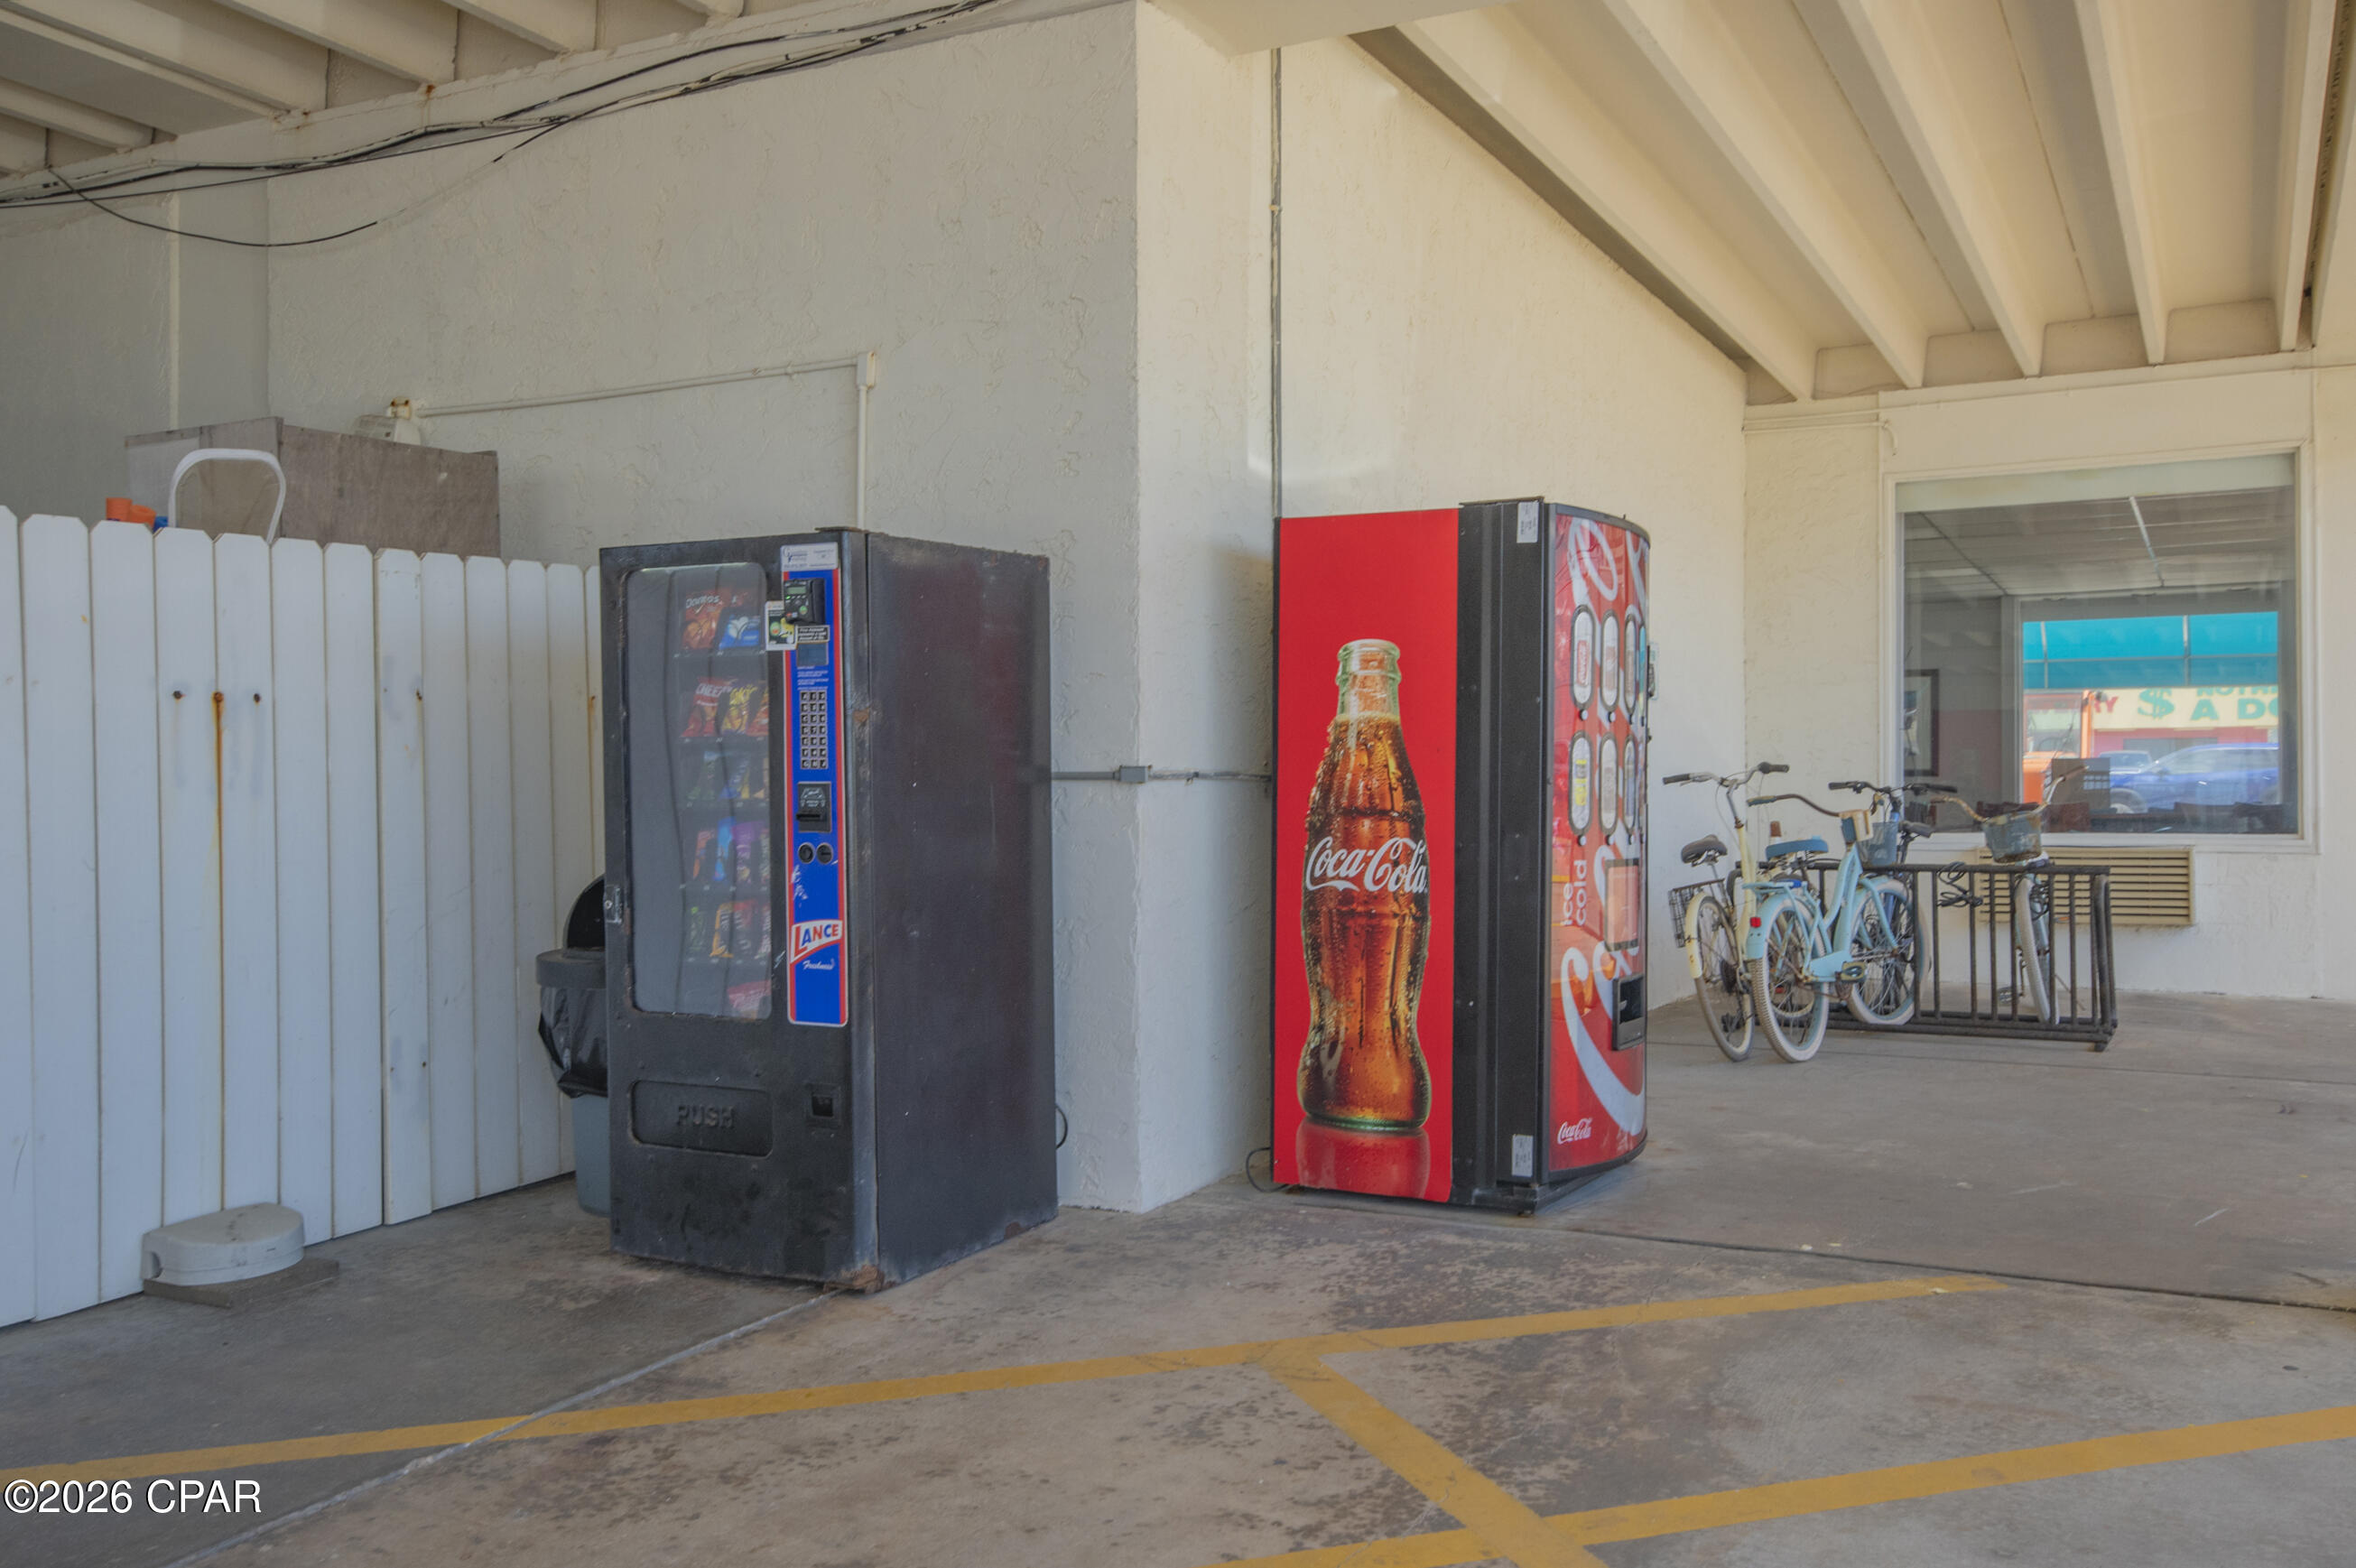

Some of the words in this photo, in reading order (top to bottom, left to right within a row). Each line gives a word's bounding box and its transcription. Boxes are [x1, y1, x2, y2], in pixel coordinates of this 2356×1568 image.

[2190, 698, 2219, 720] A
[1305, 836, 1428, 893] Coca-Cola
[1560, 883, 1573, 926] ice
[1574, 859, 1587, 926] cold
[794, 923, 839, 958] LANCE
[678, 1105, 735, 1128] PUSH
